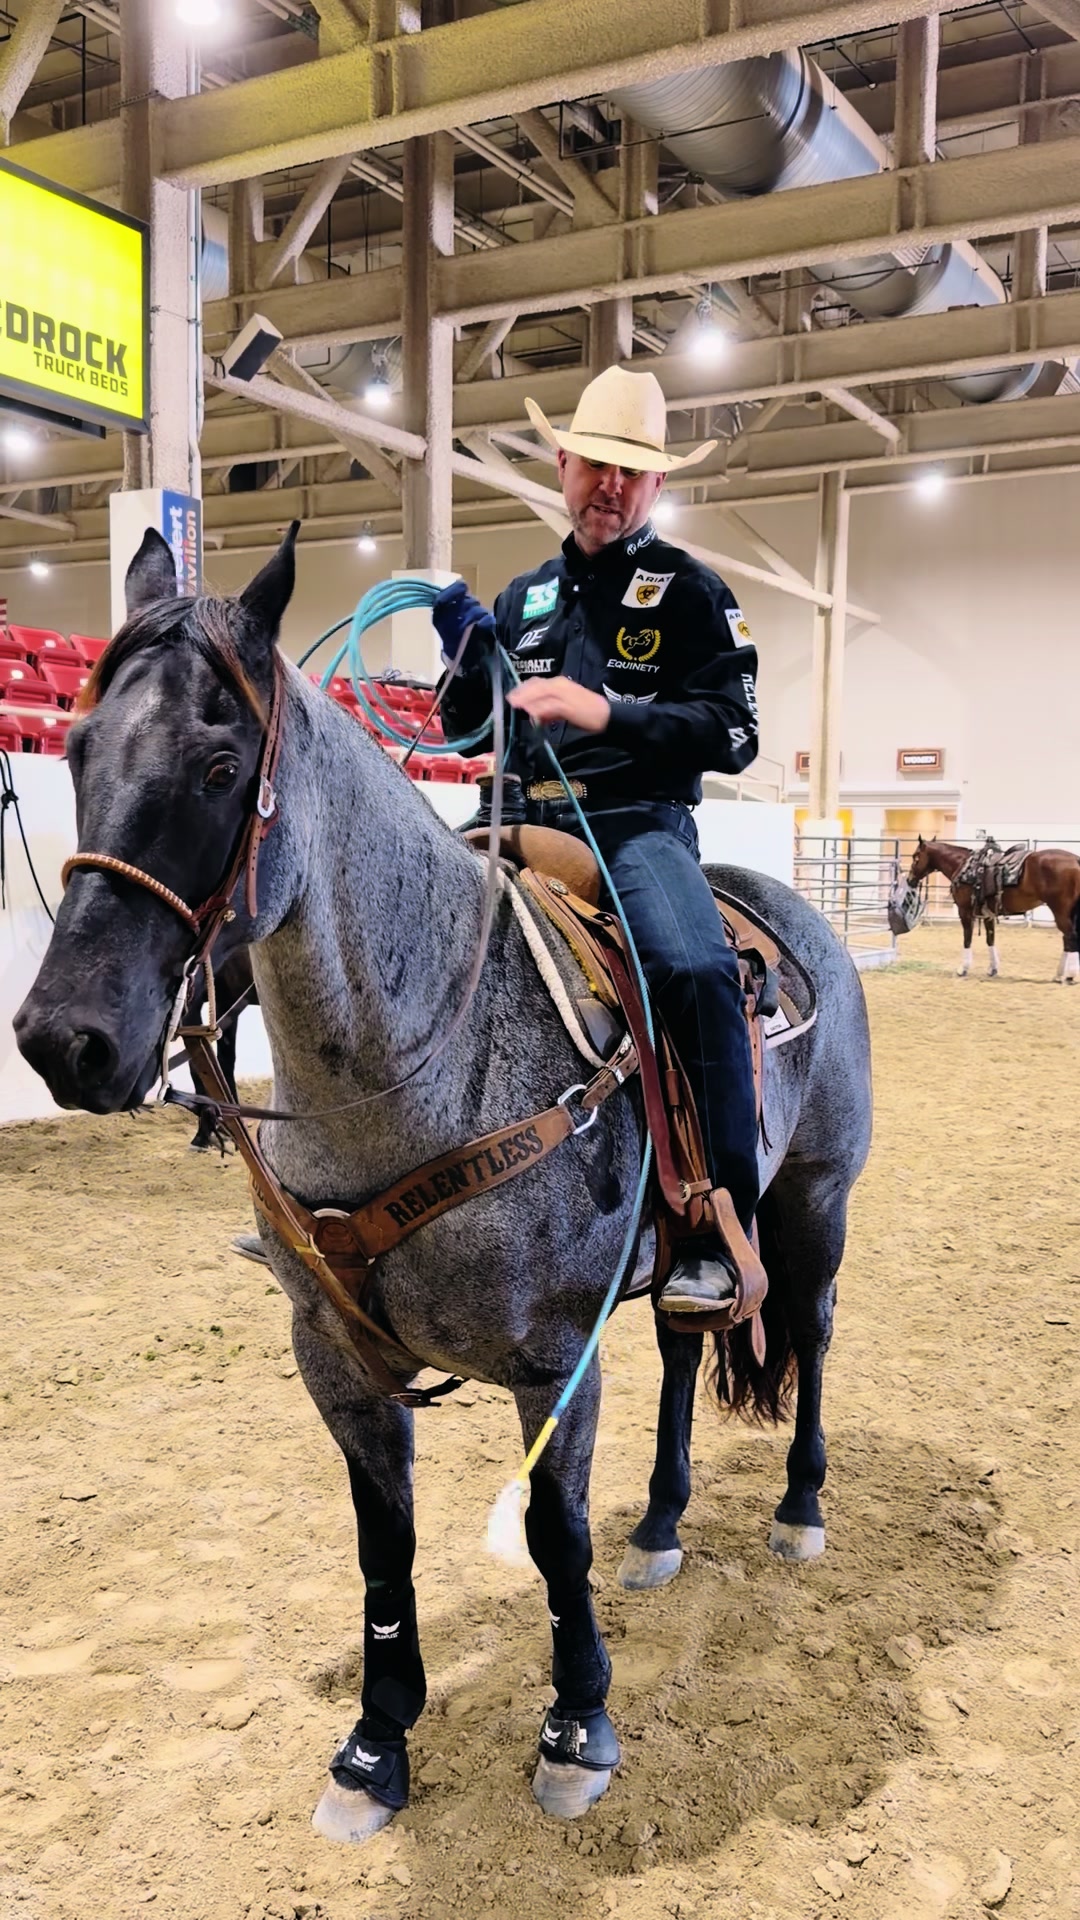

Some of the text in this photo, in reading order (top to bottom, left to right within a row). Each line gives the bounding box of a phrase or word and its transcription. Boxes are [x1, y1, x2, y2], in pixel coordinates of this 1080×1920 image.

[0, 299, 128, 379] DROCK
[33, 351, 128, 397] TRUCK BEDS
[636, 574, 672, 583] ARIAT
[607, 659, 660, 673] EQUINETY
[384, 1125, 544, 1228] RELENTLESS
